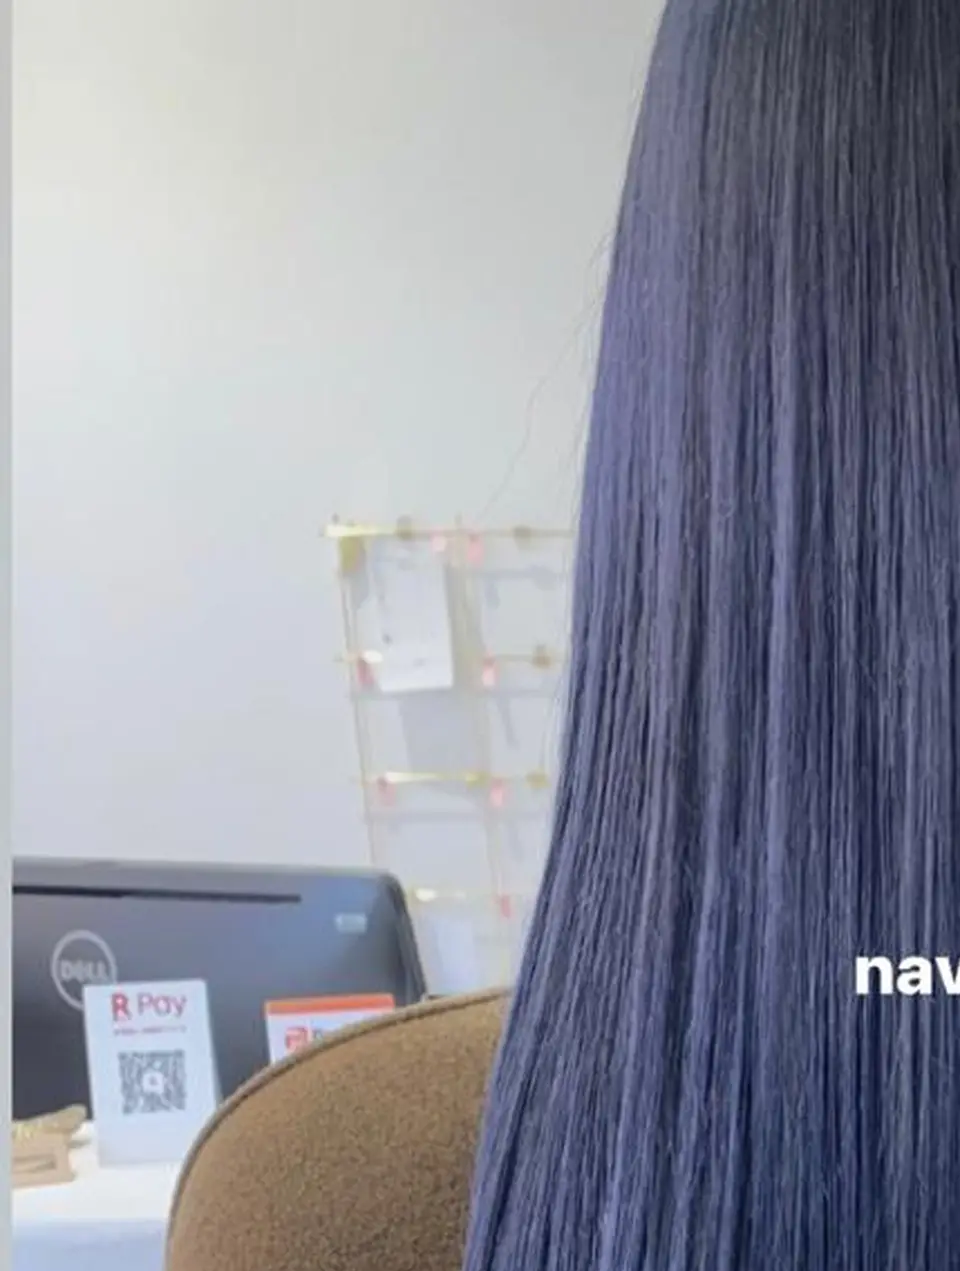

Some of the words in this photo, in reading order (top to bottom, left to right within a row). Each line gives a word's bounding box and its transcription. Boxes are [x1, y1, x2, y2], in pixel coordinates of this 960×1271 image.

[60, 959, 107, 983] DELL
[111, 992, 132, 1021] R
[137, 992, 187, 1018] Pay
